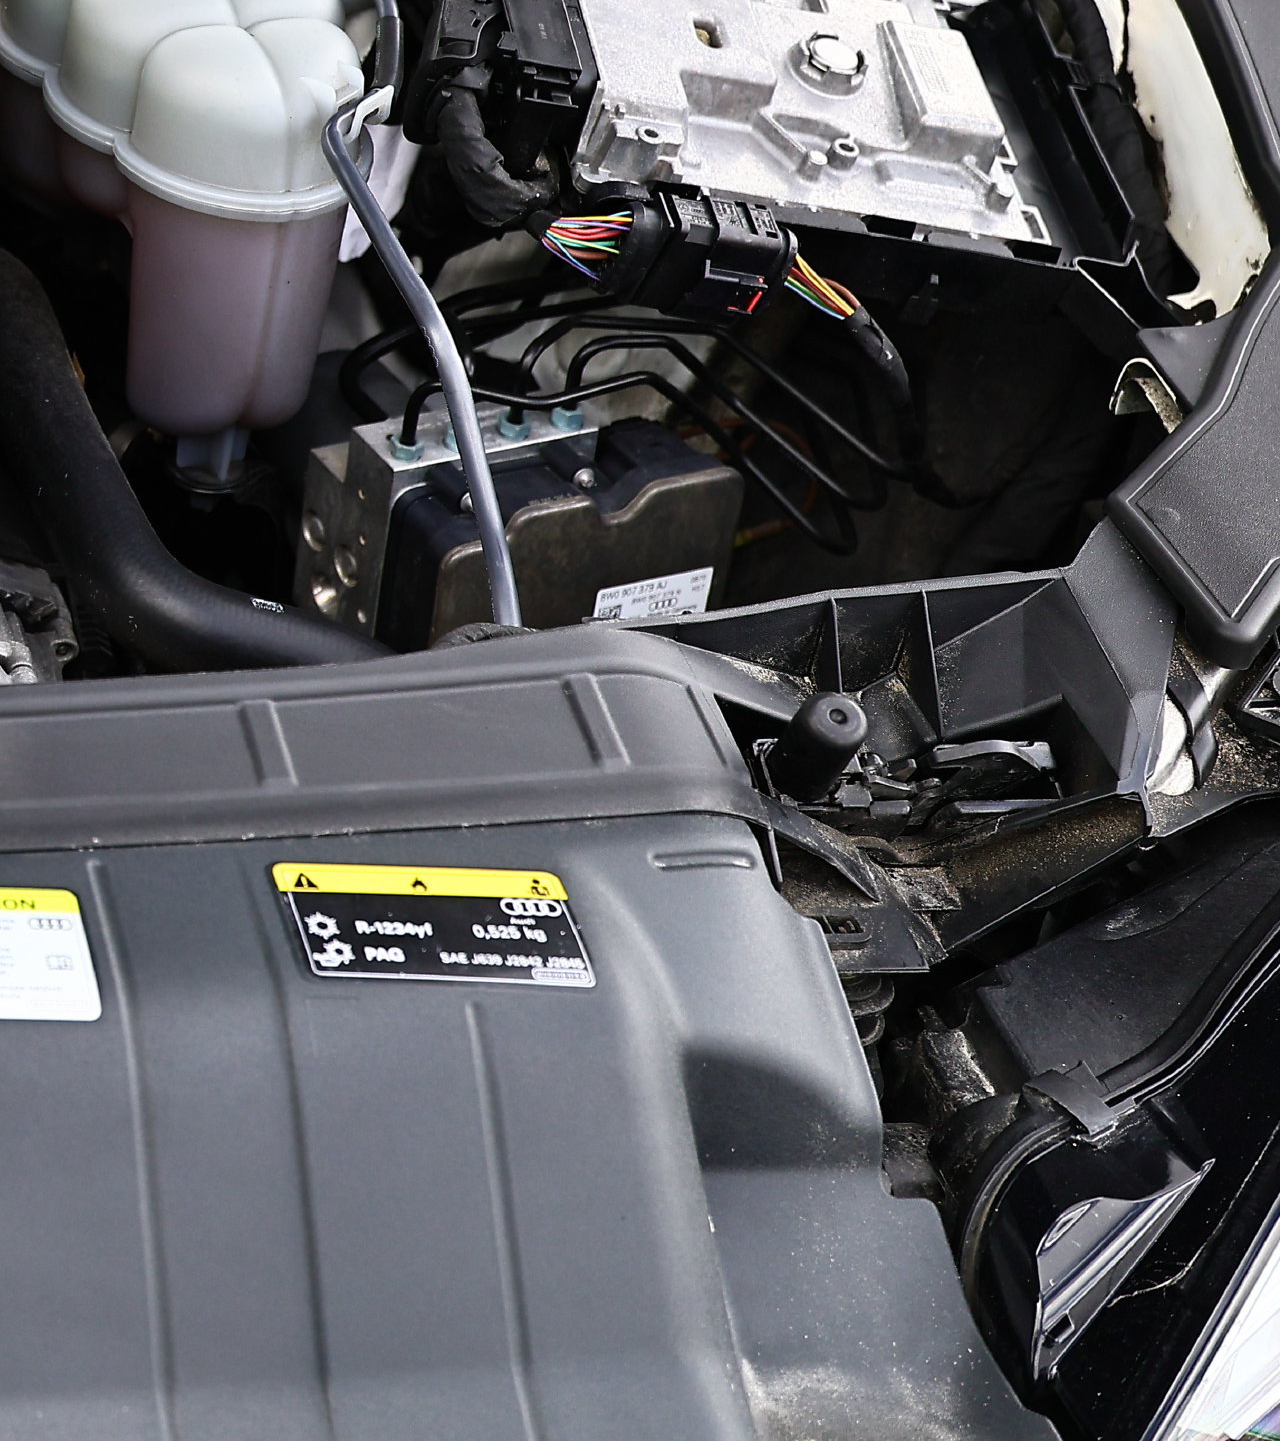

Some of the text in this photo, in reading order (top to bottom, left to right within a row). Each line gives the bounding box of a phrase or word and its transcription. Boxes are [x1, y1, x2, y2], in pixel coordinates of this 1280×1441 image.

[621, 587, 638, 599] 907
[472, 924, 548, 943] 0,525 kg
[365, 945, 407, 964] PAG
[439, 950, 469, 965] SAE
